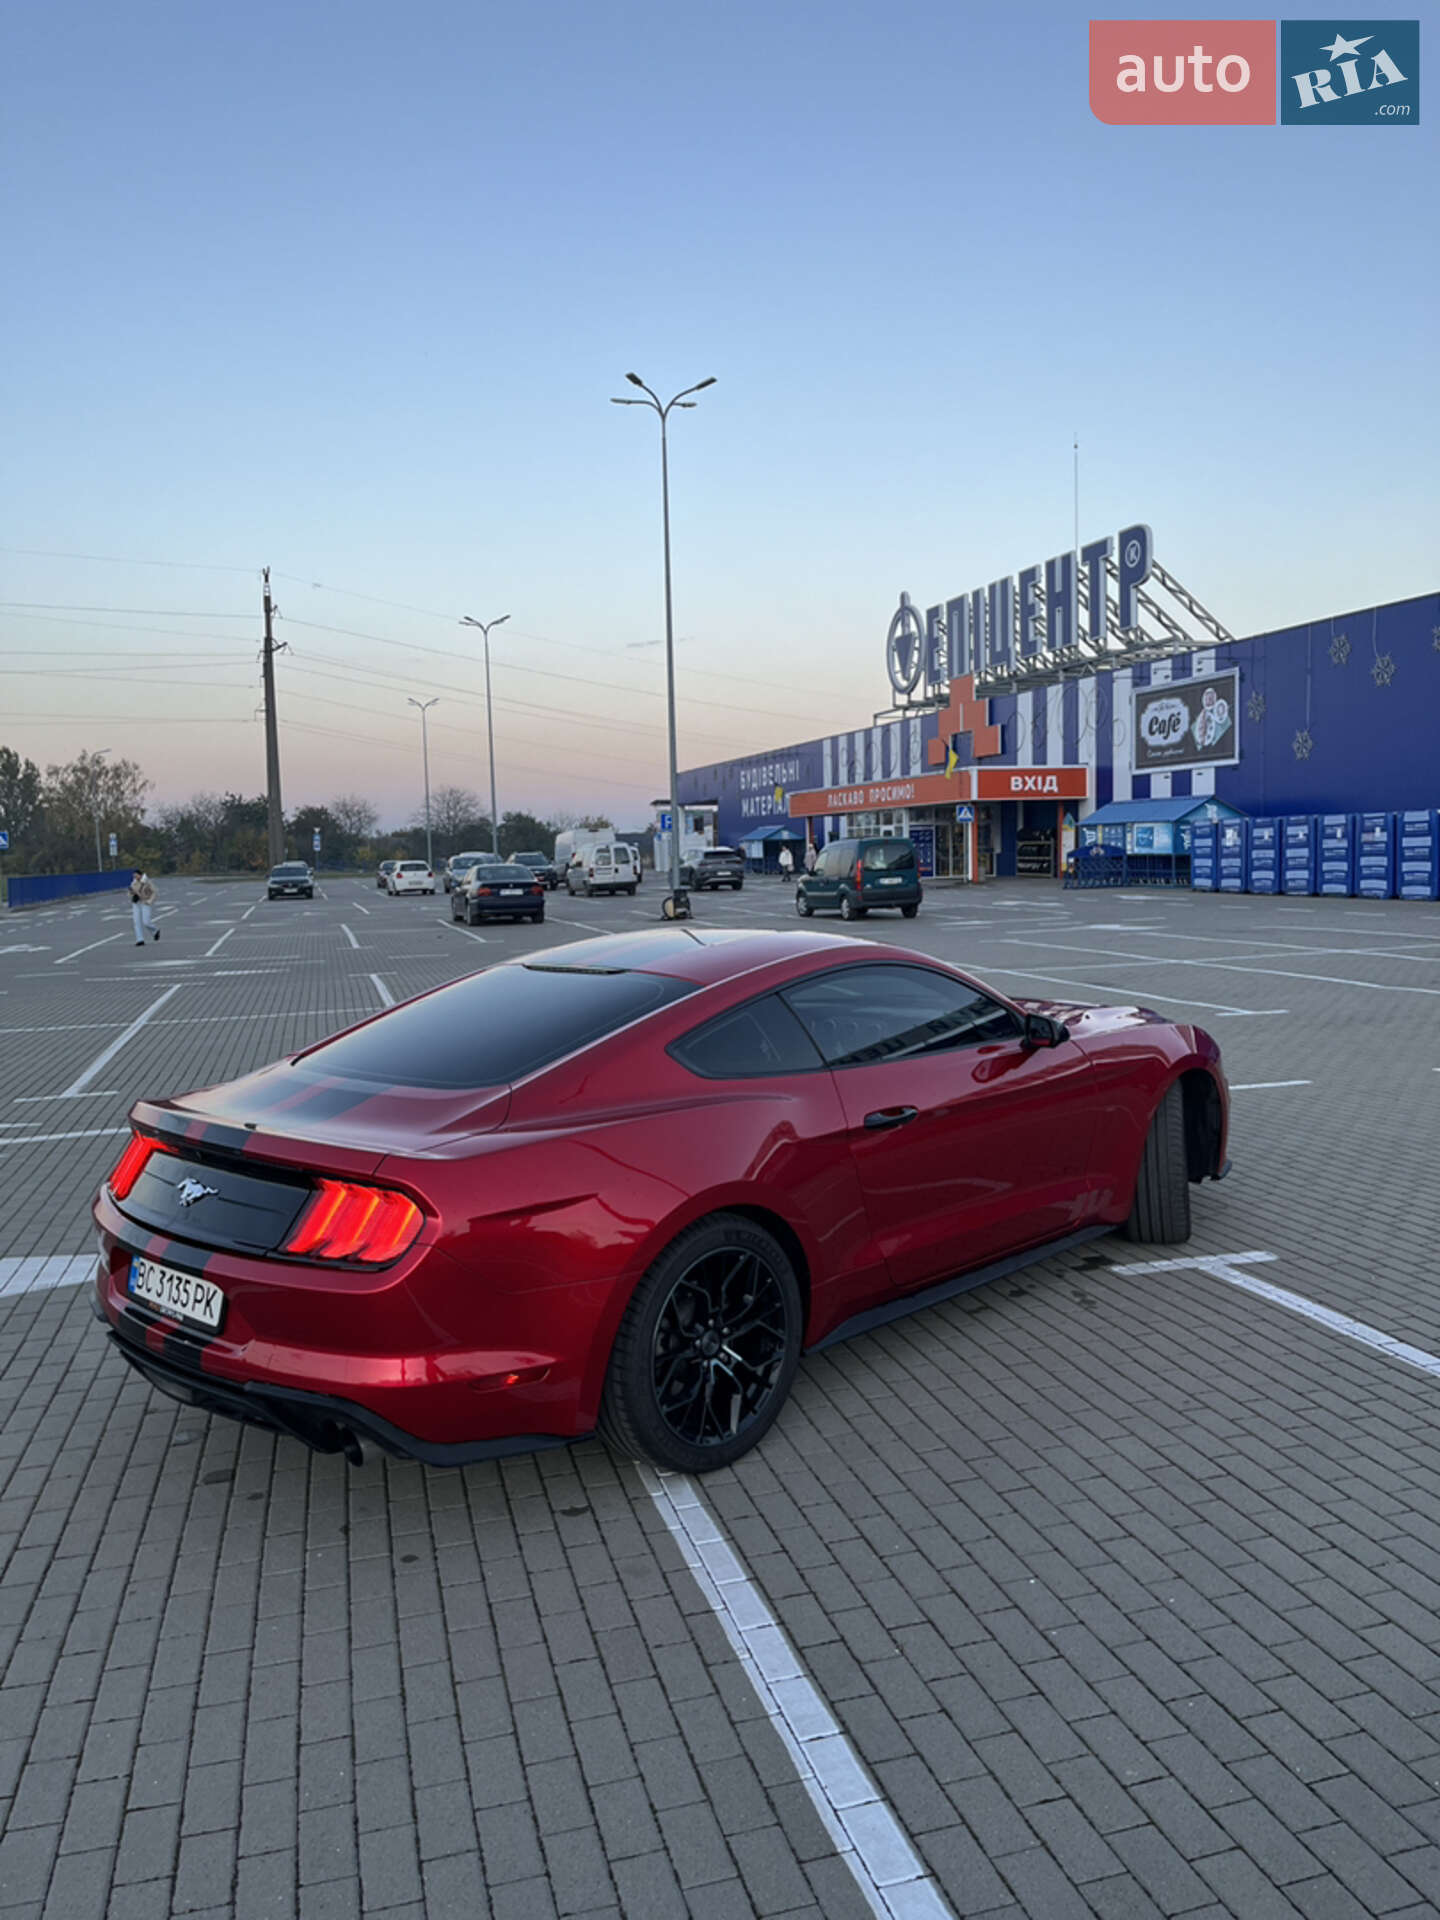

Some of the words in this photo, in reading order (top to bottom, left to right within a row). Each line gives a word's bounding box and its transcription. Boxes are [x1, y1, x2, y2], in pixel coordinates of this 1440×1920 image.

[926, 524, 1153, 687] ЕПІЦЕНТР
[1149, 711, 1181, 740] Café
[1010, 774, 1059, 793] ВХІД
[156, 1269, 191, 1308] 3135
